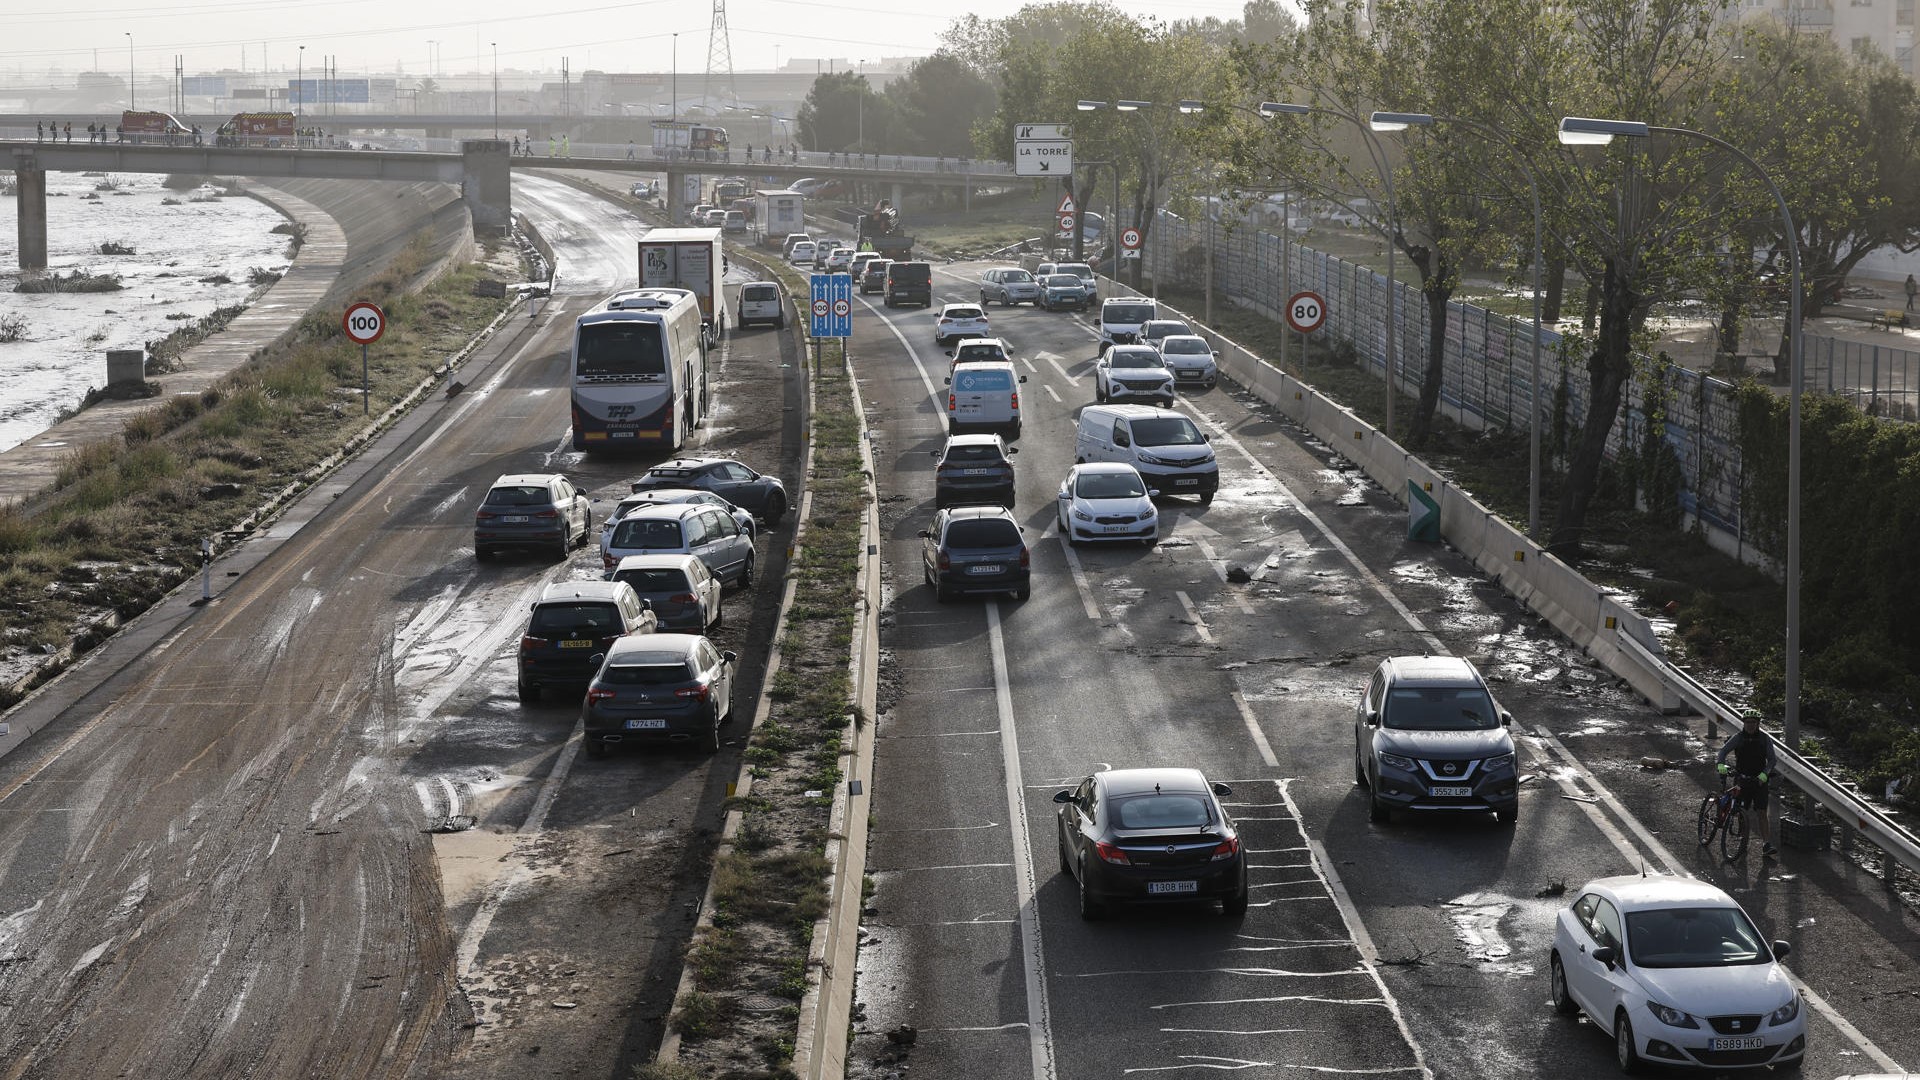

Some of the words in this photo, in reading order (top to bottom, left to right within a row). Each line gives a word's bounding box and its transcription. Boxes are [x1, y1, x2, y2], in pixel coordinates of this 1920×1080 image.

[1125, 234, 1137, 242] 60
[837, 304, 847, 312] 80
[1295, 305, 1317, 318] 80
[351, 316, 378, 330] 100
[632, 720, 648, 728] 4774
[1434, 788, 1453, 796] 3552
[1455, 788, 1469, 796] LRP
[1155, 883, 1176, 892] 1308
[1178, 882, 1194, 891] HHK
[1716, 1039, 1741, 1049] 6989
[1744, 1038, 1762, 1048] HKD
